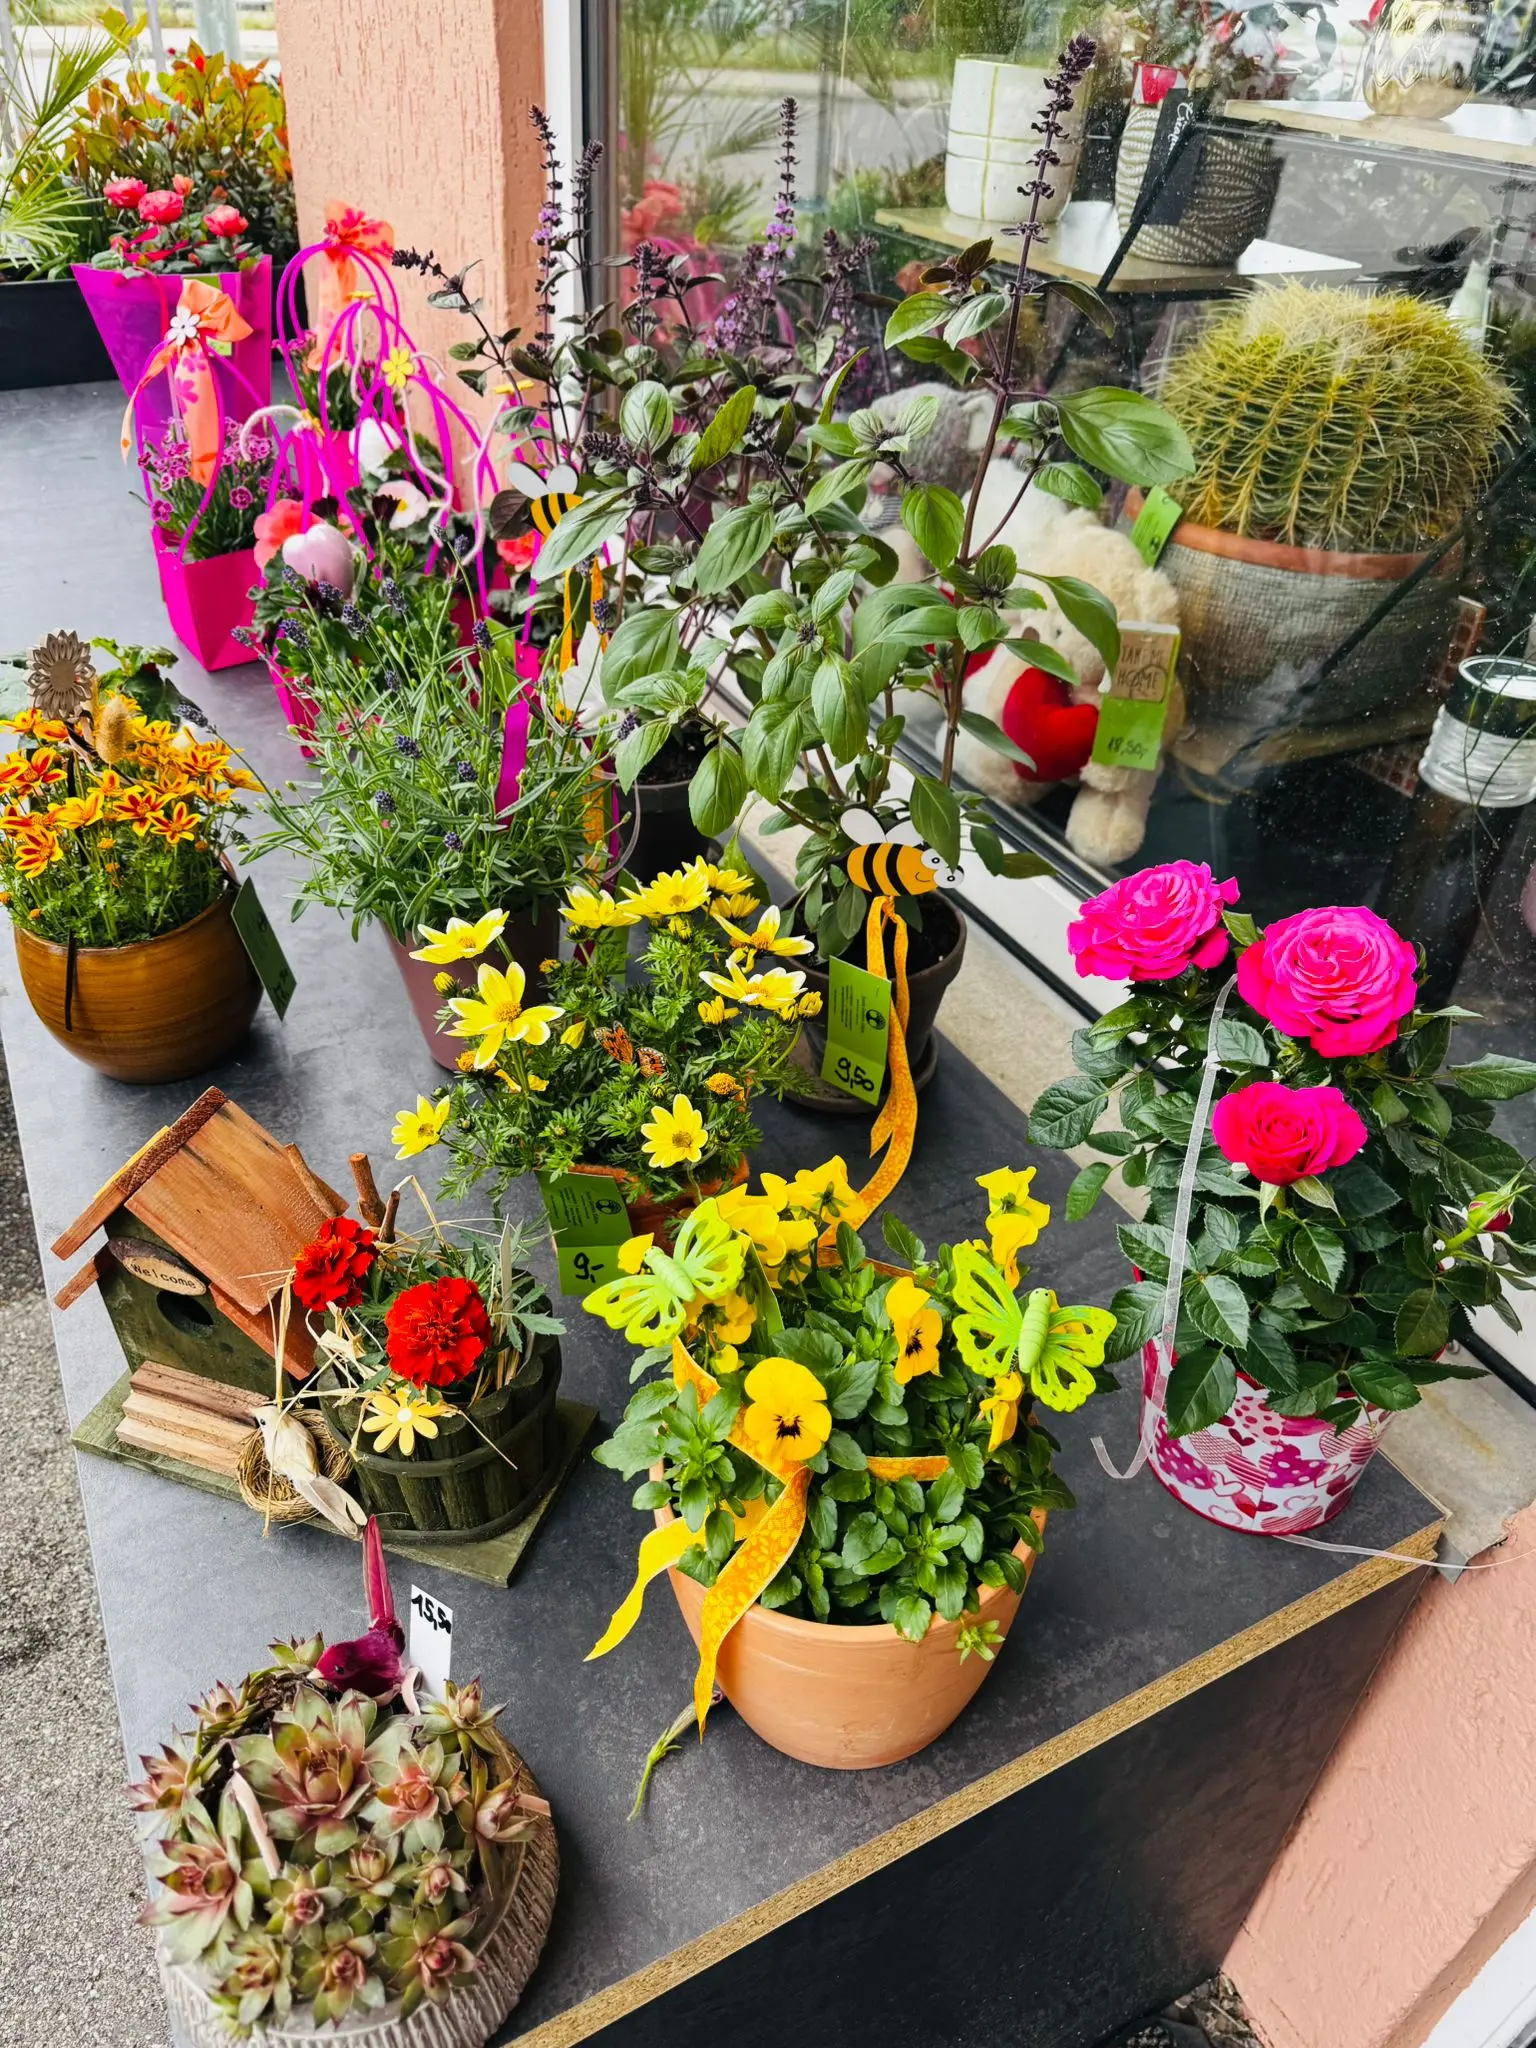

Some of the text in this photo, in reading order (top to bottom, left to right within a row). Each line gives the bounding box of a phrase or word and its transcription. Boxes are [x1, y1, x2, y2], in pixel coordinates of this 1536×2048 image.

[834, 1056, 875, 1092] 9,50
[130, 1263, 197, 1289] Welcome
[573, 1251, 605, 1284] 9,-
